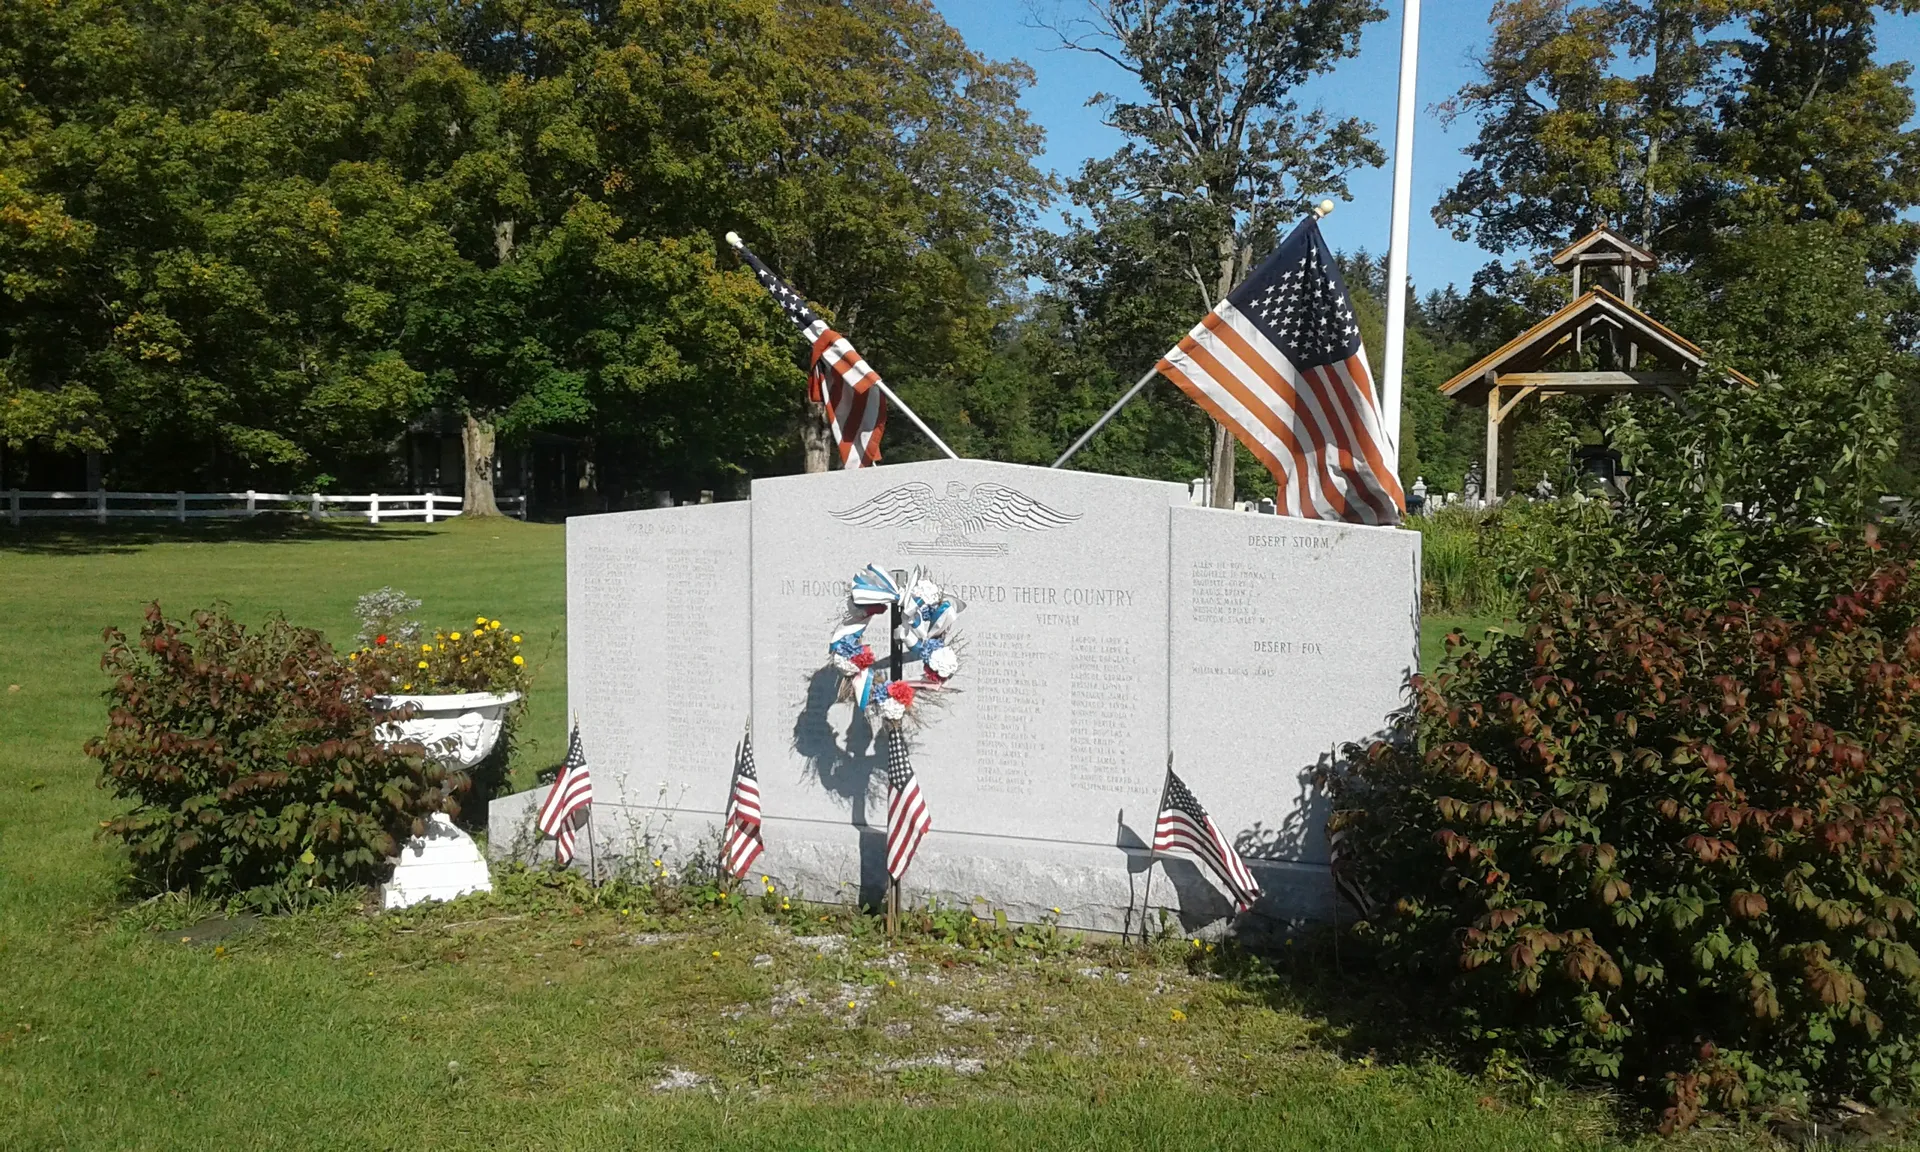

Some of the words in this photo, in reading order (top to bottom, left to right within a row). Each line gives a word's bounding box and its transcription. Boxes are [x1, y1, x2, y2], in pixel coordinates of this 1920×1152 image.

[1248, 535, 1287, 547] DESERT
[1293, 536, 1329, 549] STORM
[781, 580, 796, 596] IN
[952, 585, 1006, 603] SERVED
[1013, 586, 1057, 604] THEIR
[1063, 588, 1135, 607] COUNTRY
[1036, 613, 1079, 626] VIETNAM
[1253, 640, 1292, 654] DESERT
[1301, 642, 1323, 656] FOX
